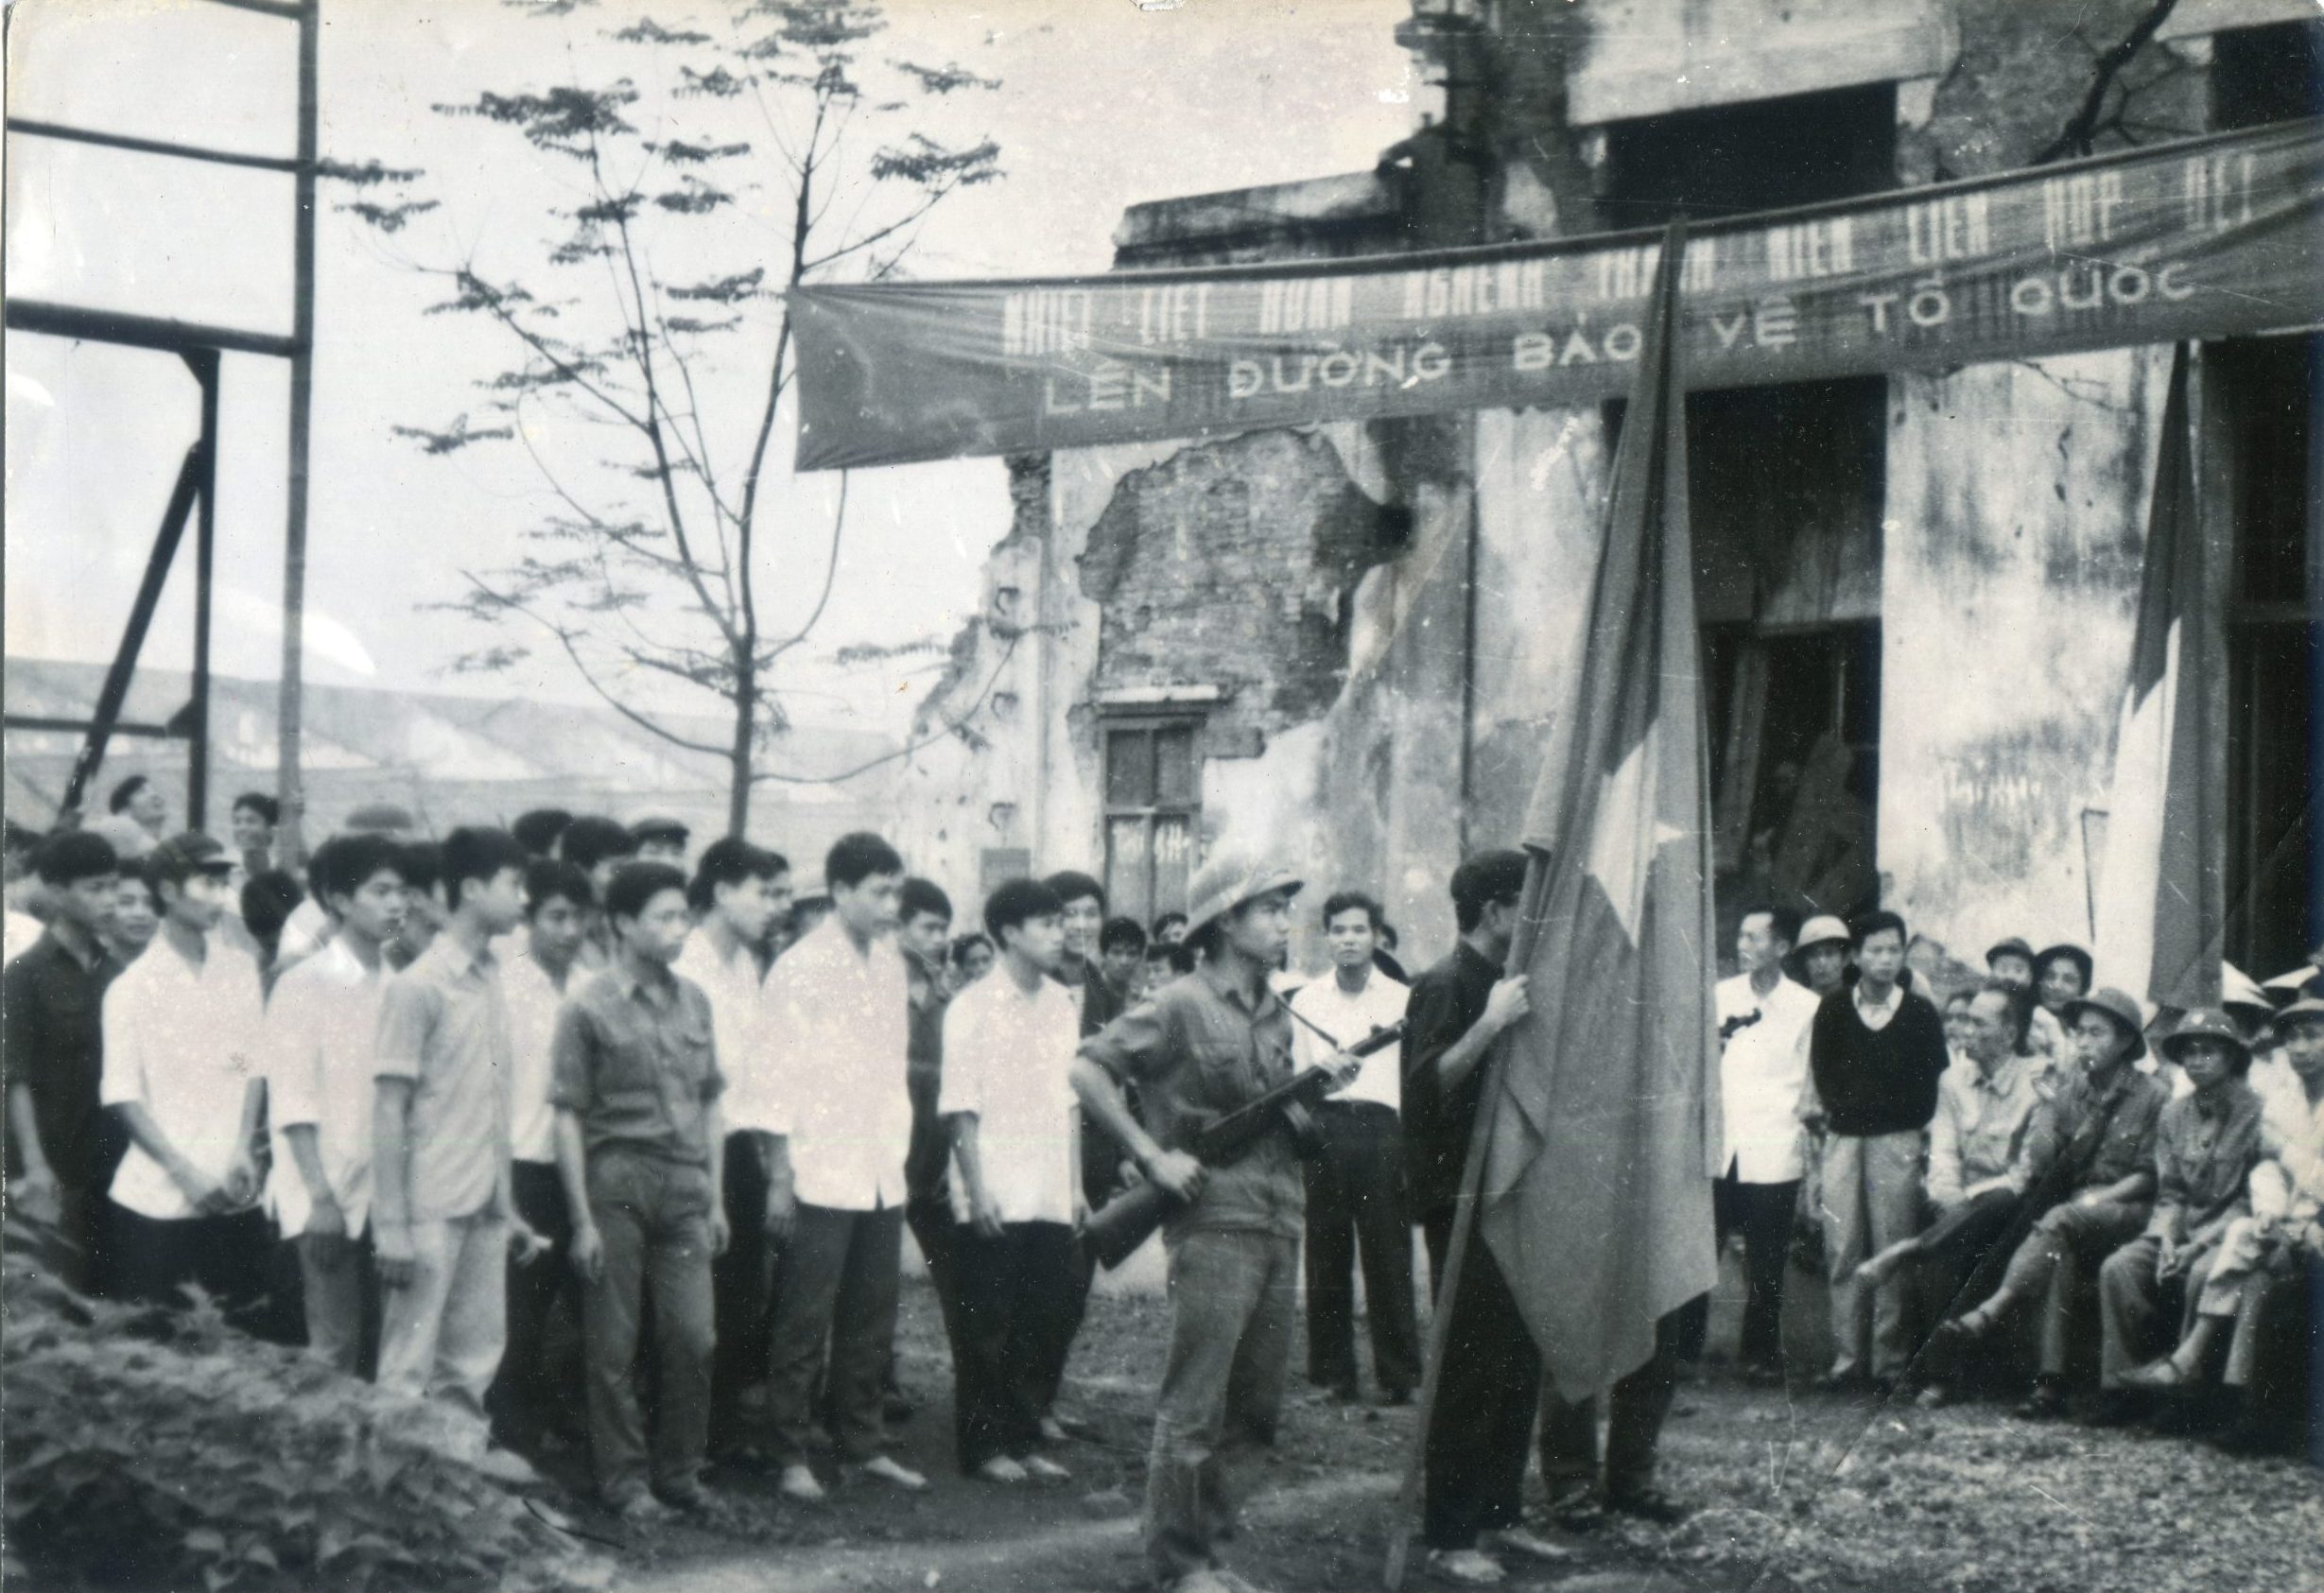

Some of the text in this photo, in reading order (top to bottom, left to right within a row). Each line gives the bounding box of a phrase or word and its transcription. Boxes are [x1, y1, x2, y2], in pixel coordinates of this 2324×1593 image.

[1045, 246, 2195, 414] LÊN ĐƯỜNG BẢO VỆ TỔ QUỐC
